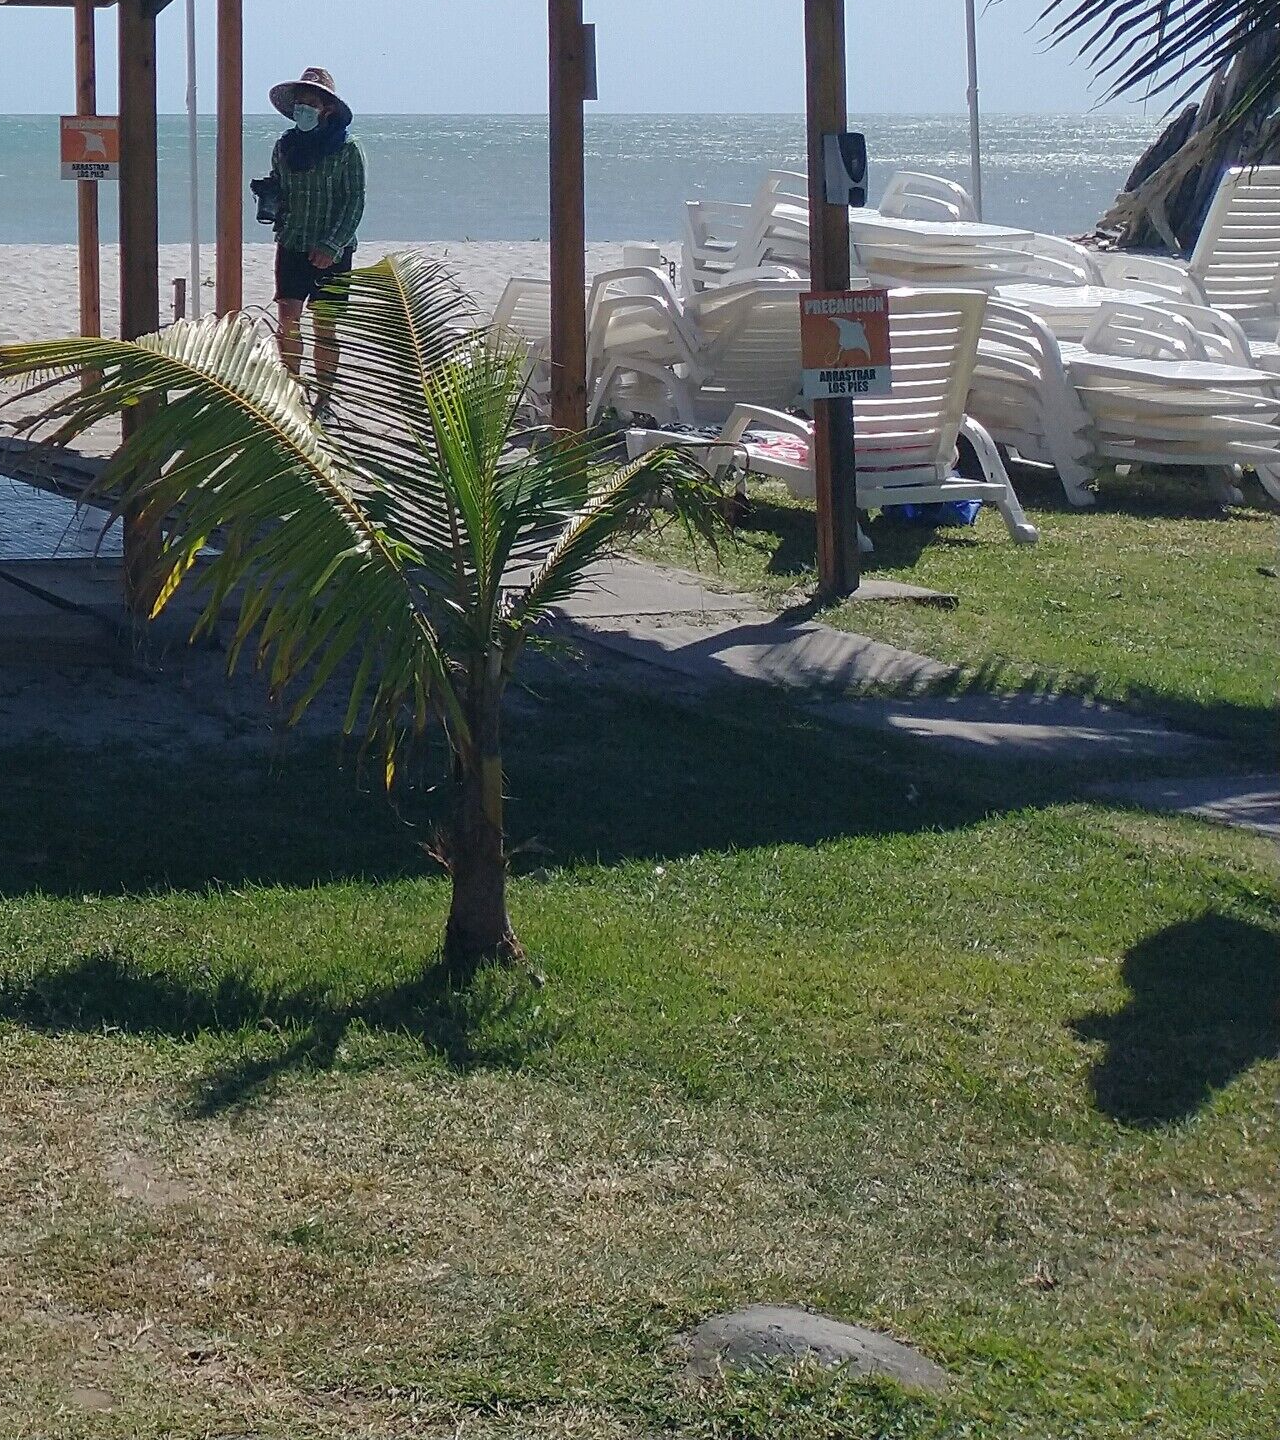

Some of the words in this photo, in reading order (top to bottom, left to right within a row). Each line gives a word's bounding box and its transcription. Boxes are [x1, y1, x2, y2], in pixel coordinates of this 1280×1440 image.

[820, 369, 876, 382] ARRASTRAR
[829, 382, 845, 393] LOS
[848, 381, 868, 393] PIES
